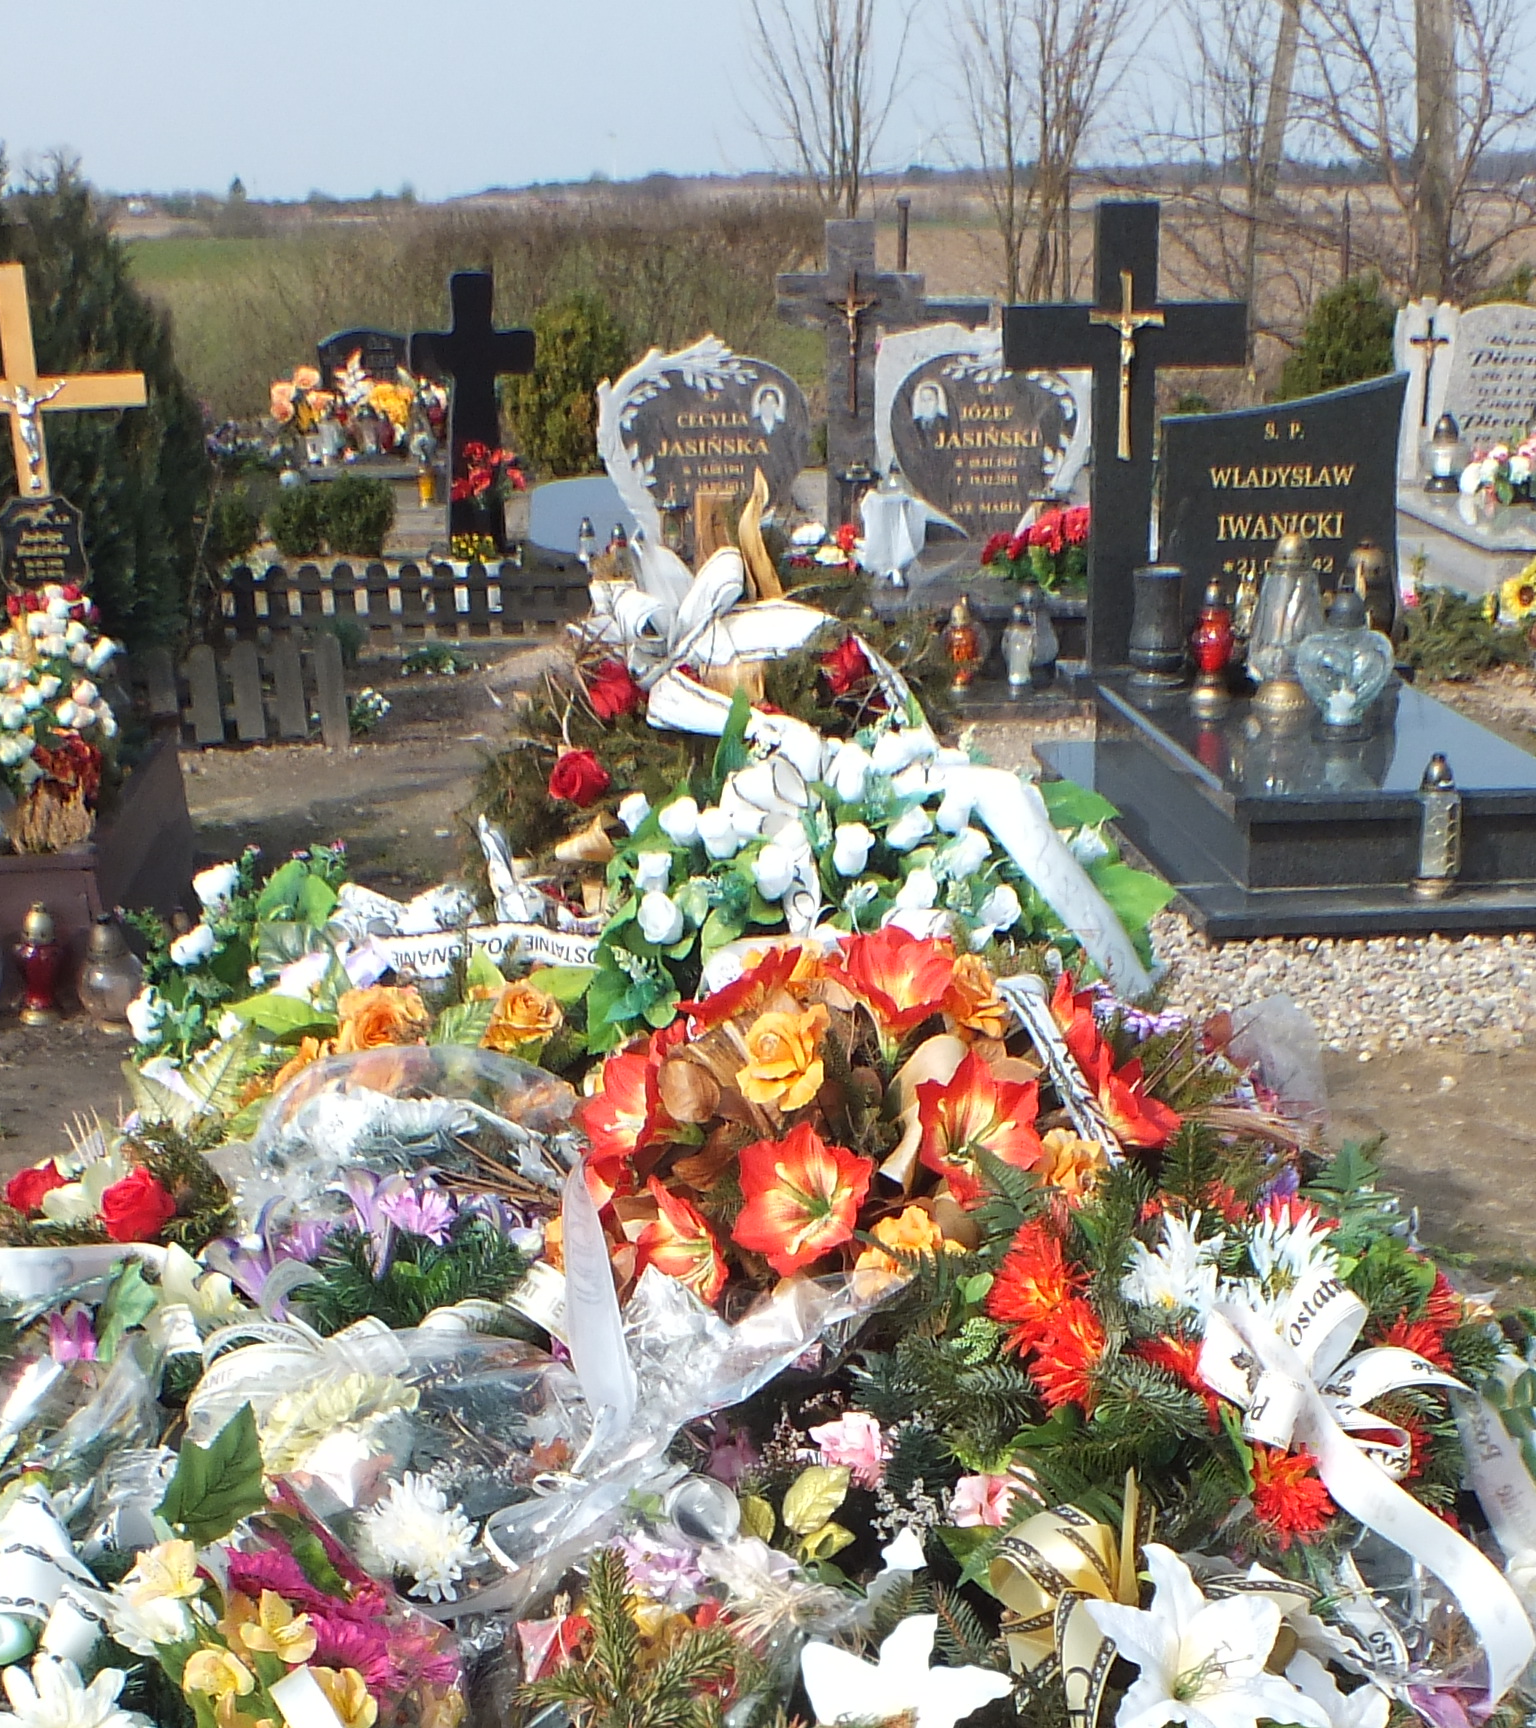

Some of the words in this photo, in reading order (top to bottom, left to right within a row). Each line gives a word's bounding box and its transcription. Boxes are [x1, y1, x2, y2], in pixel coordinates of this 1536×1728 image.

[676, 412, 749, 428] CECYLIA
[960, 402, 1015, 421] JÓZEF
[657, 433, 770, 457] JASIŃSKA
[934, 426, 1039, 450] JASIŃSKI
[1216, 512, 1345, 542] IWANICKI
